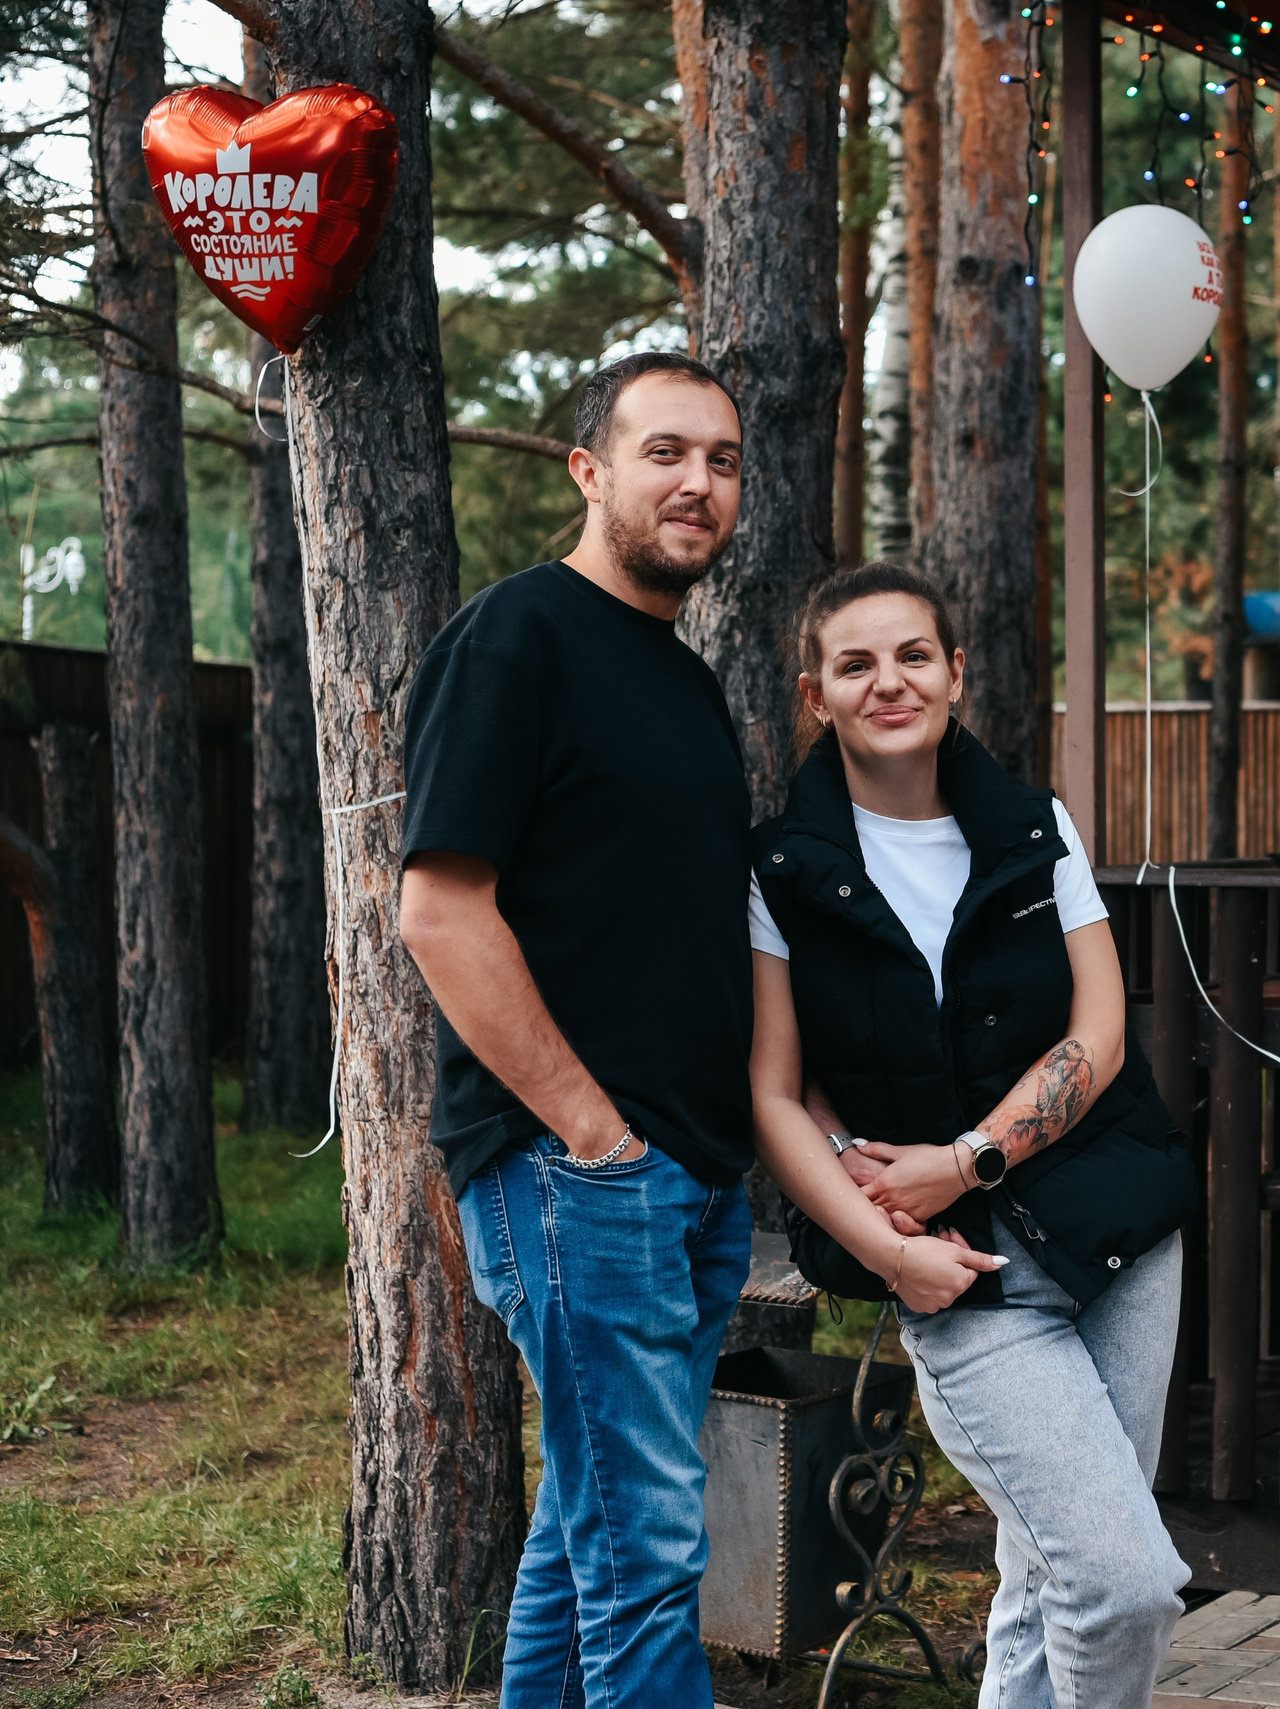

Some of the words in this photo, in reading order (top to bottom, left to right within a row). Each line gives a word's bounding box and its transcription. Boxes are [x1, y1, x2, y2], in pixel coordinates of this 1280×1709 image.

[164, 171, 318, 214] КОРОЛЕВА
[206, 210, 270, 233] ЭТО
[191, 233, 298, 254] СОСТОЯНИЕ
[204, 256, 294, 281] ДУШИ!
